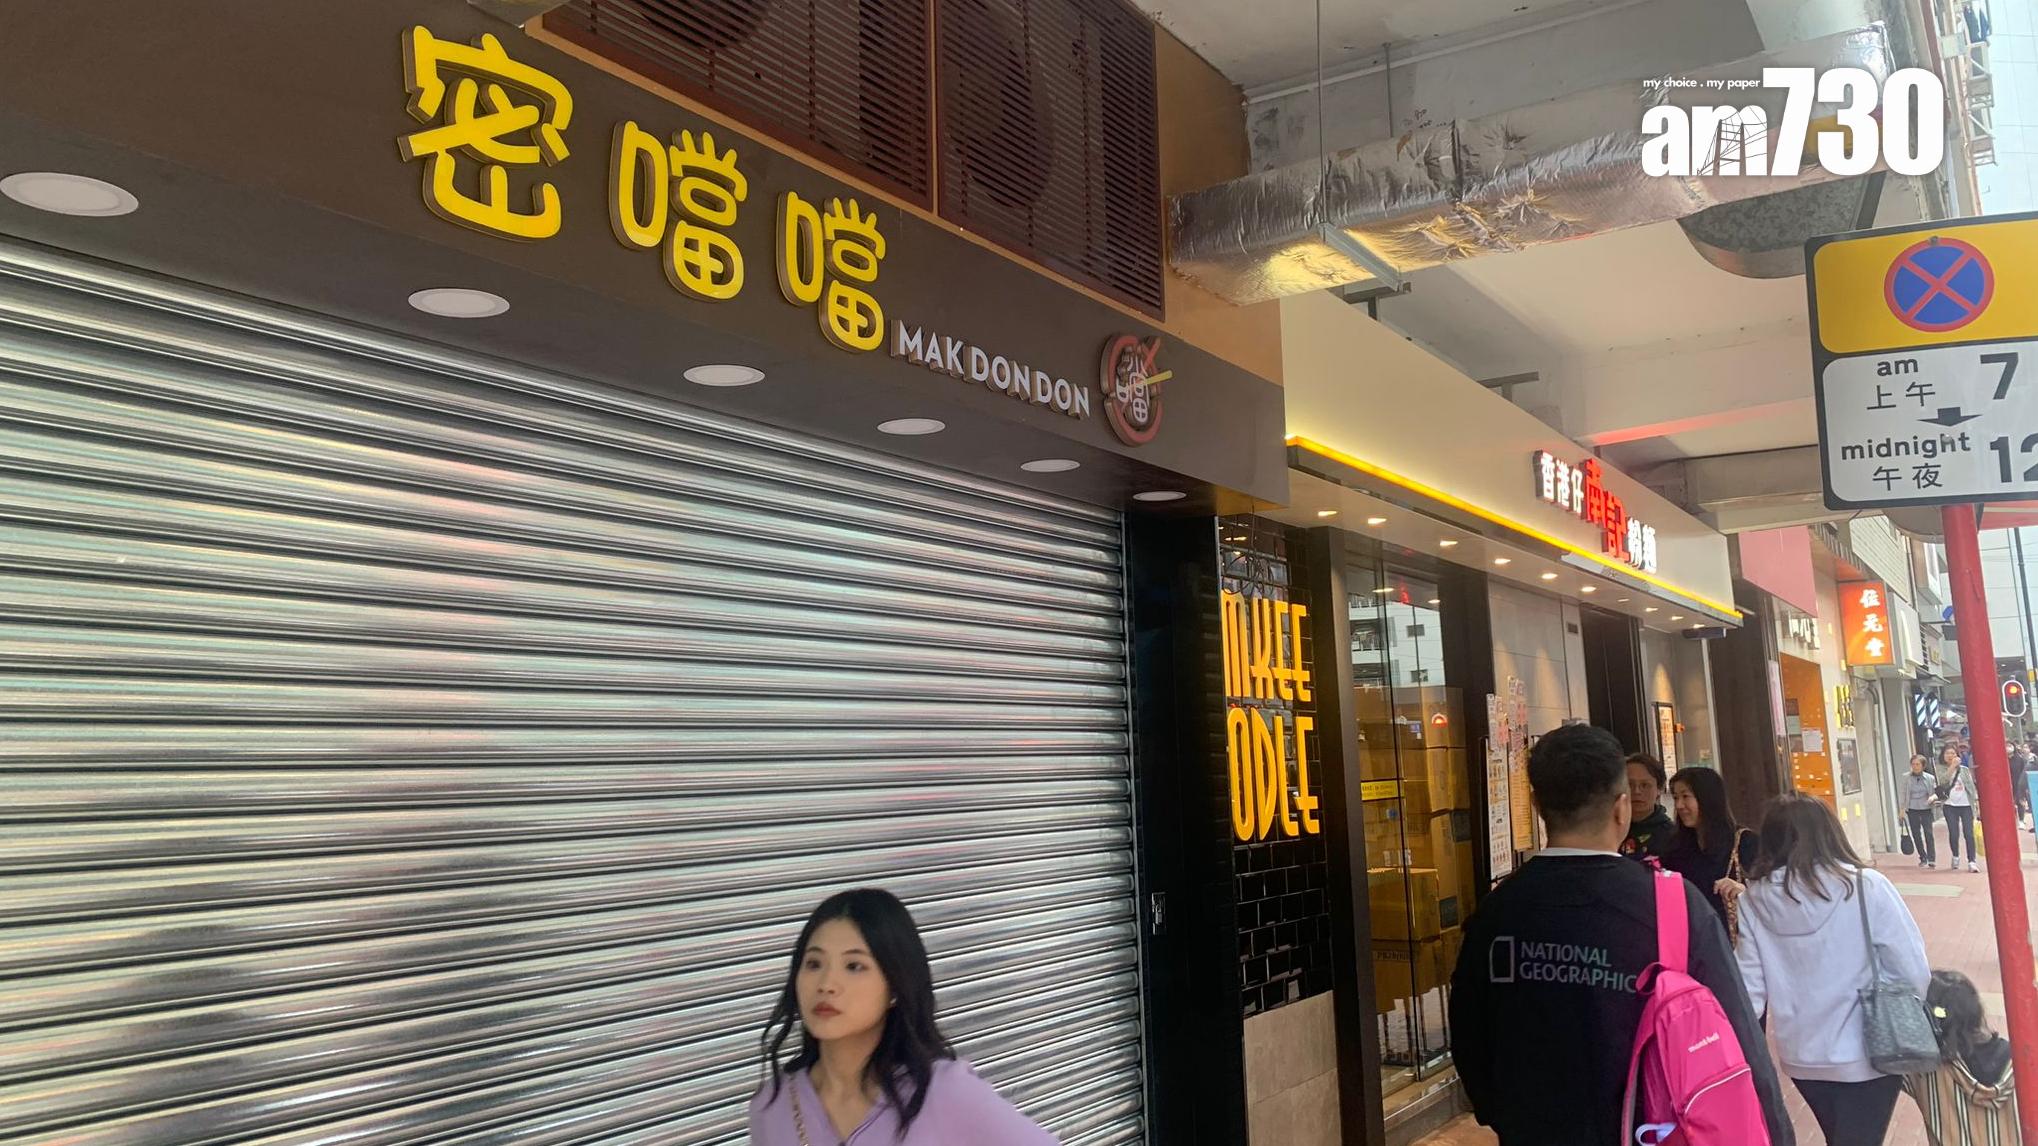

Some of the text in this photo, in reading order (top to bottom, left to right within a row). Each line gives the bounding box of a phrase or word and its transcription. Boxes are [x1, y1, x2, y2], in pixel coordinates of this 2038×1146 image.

[398, 25, 887, 353] 密噹噹
[892, 320, 964, 376] MAK
[1877, 352, 2019, 400] am 7
[1867, 382, 1935, 410] 上午
[1841, 432, 1971, 460] midnight
[1872, 464, 1943, 491] 午夜
[1521, 941, 1612, 967] NATIONAL
[1520, 962, 1637, 993] GEOGRAPHIC
